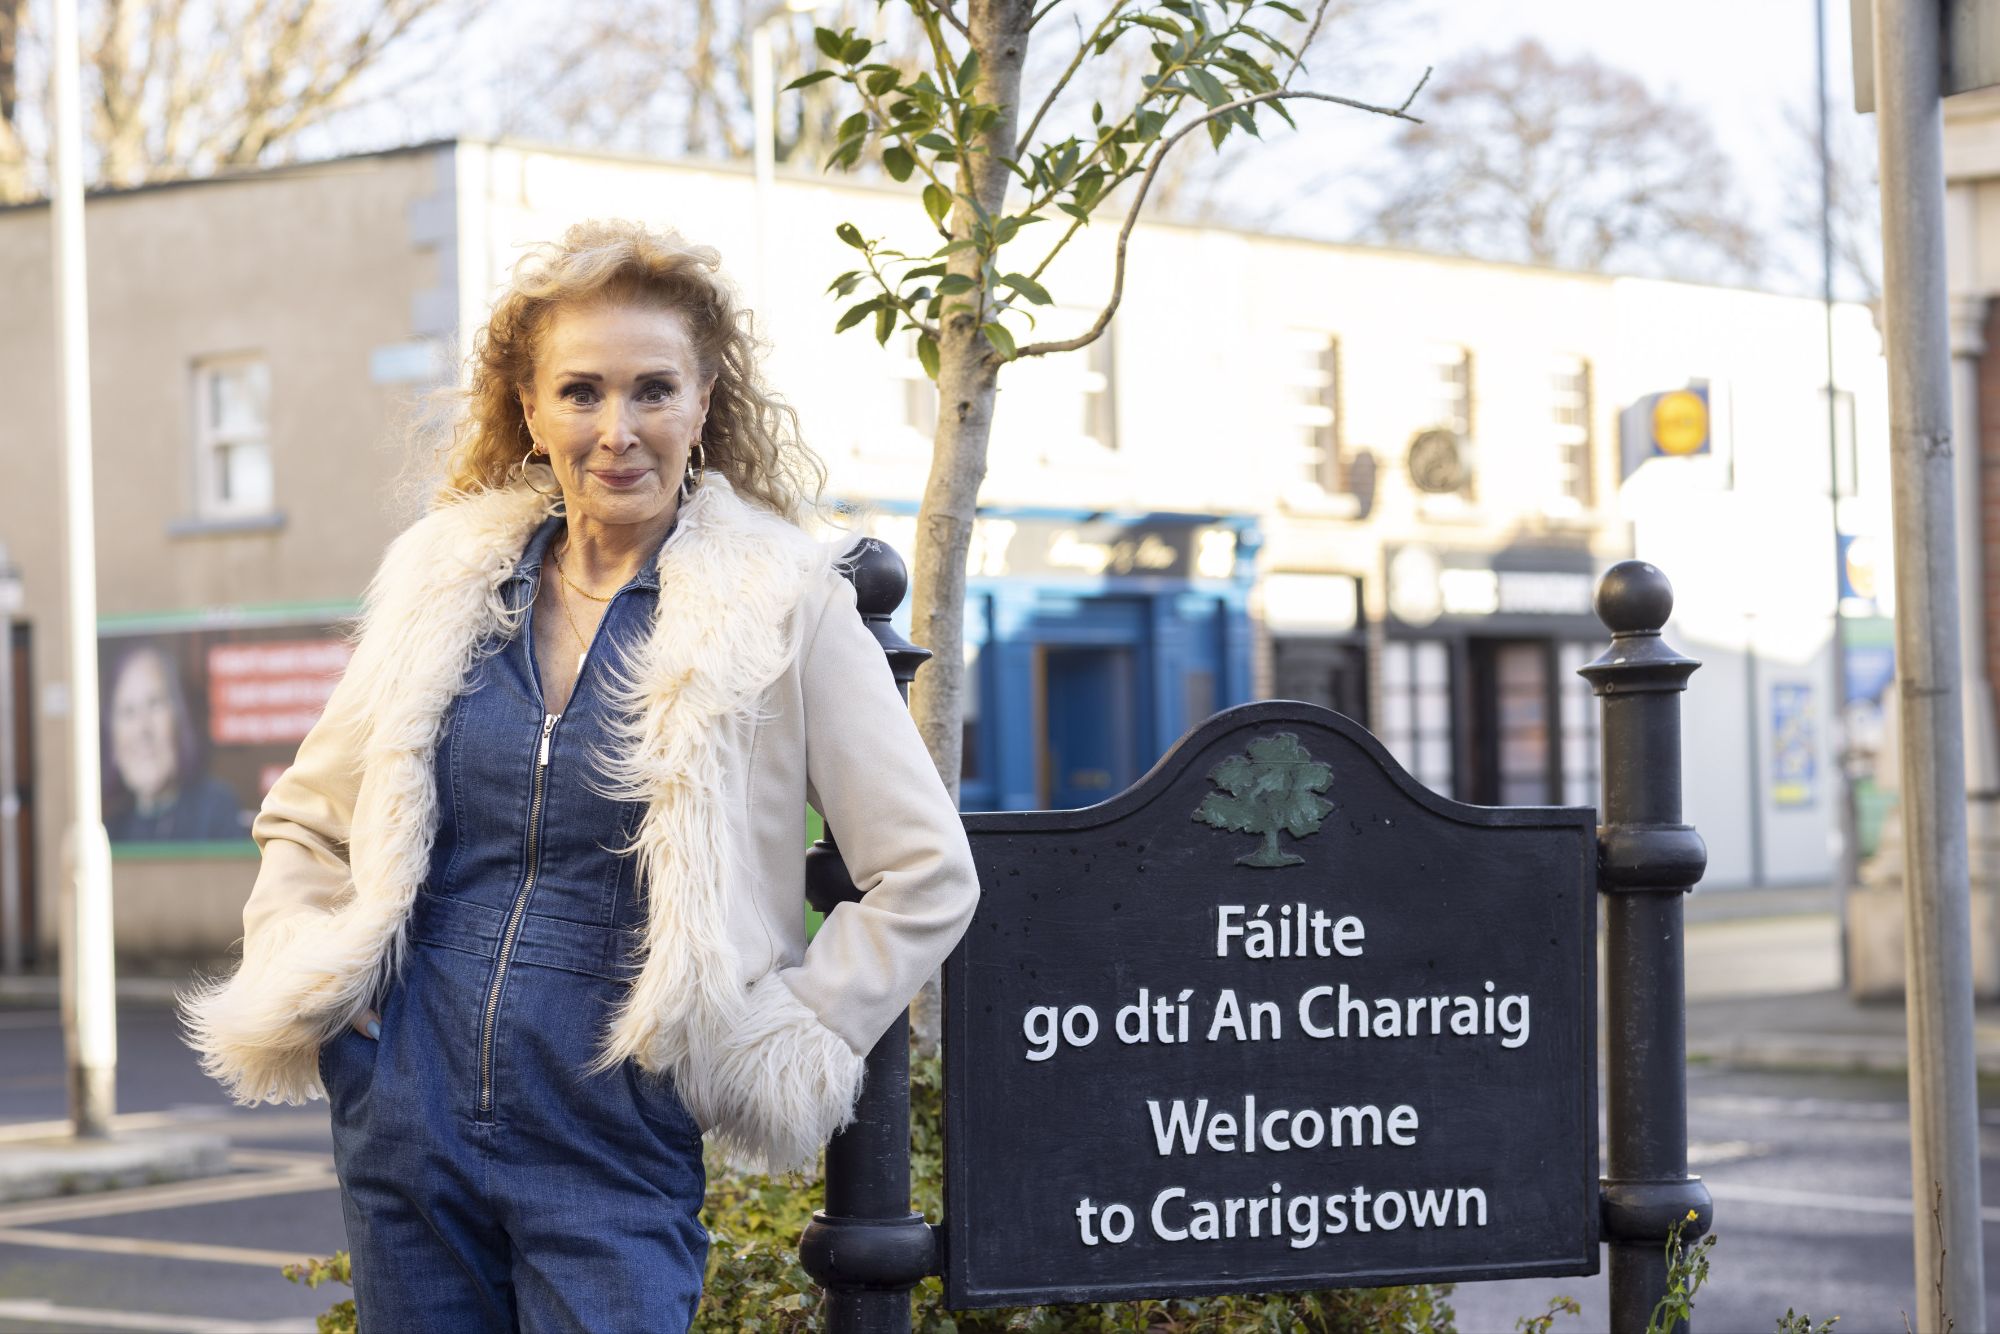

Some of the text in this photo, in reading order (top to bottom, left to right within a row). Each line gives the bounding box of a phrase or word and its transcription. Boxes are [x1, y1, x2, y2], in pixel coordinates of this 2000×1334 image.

[1216, 903, 1365, 958] Fáilte
[1023, 980, 1530, 1061] go dtí An Charraig
[1146, 1094, 1419, 1156] Welcome
[1075, 1182, 1488, 1249] to Carrigstown
